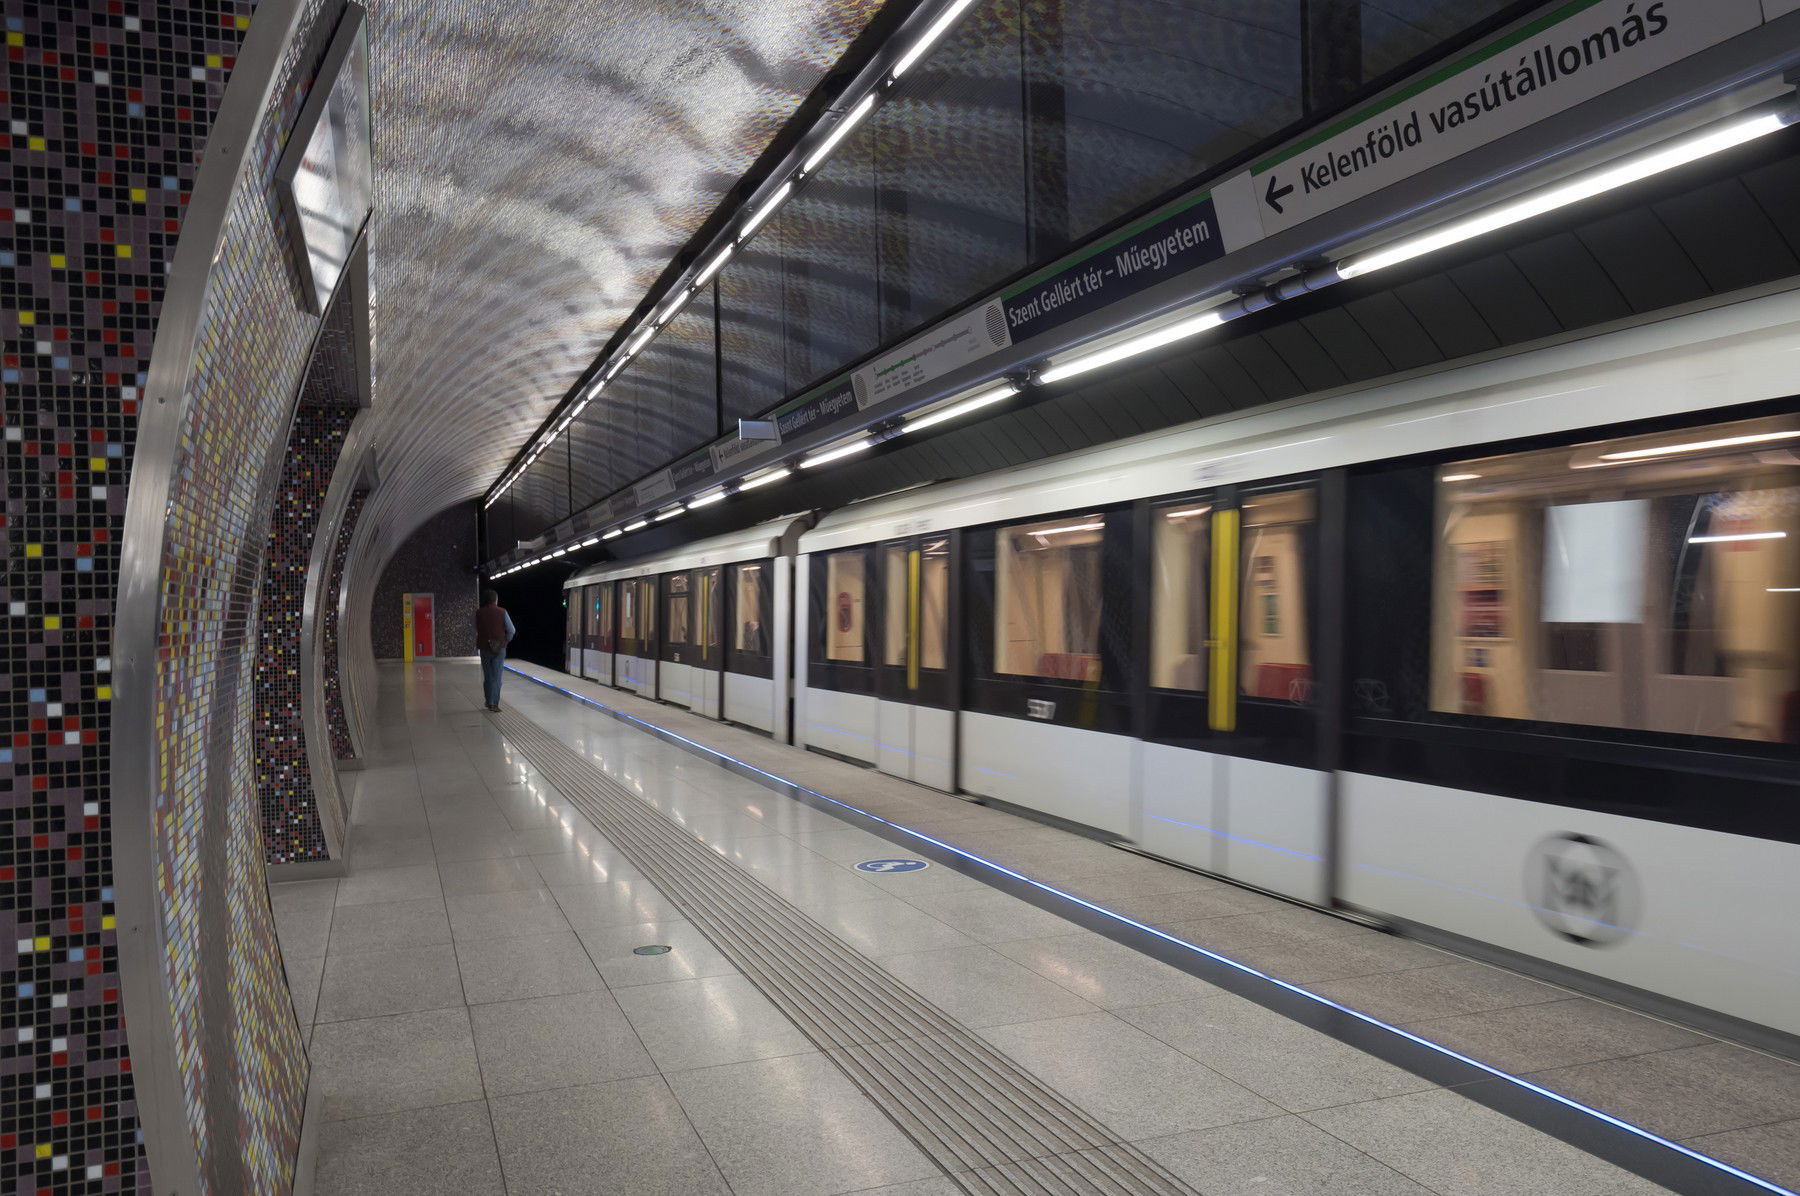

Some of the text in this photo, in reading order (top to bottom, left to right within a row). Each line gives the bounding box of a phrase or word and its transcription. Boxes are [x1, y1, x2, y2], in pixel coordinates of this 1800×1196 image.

[1301, 1, 1669, 194] Kelenföld vasútállomás
[1008, 300, 1041, 328] Szent
[1041, 277, 1083, 312] Gellért
[1083, 267, 1104, 293] tér
[1116, 220, 1209, 278] Műegyetem
